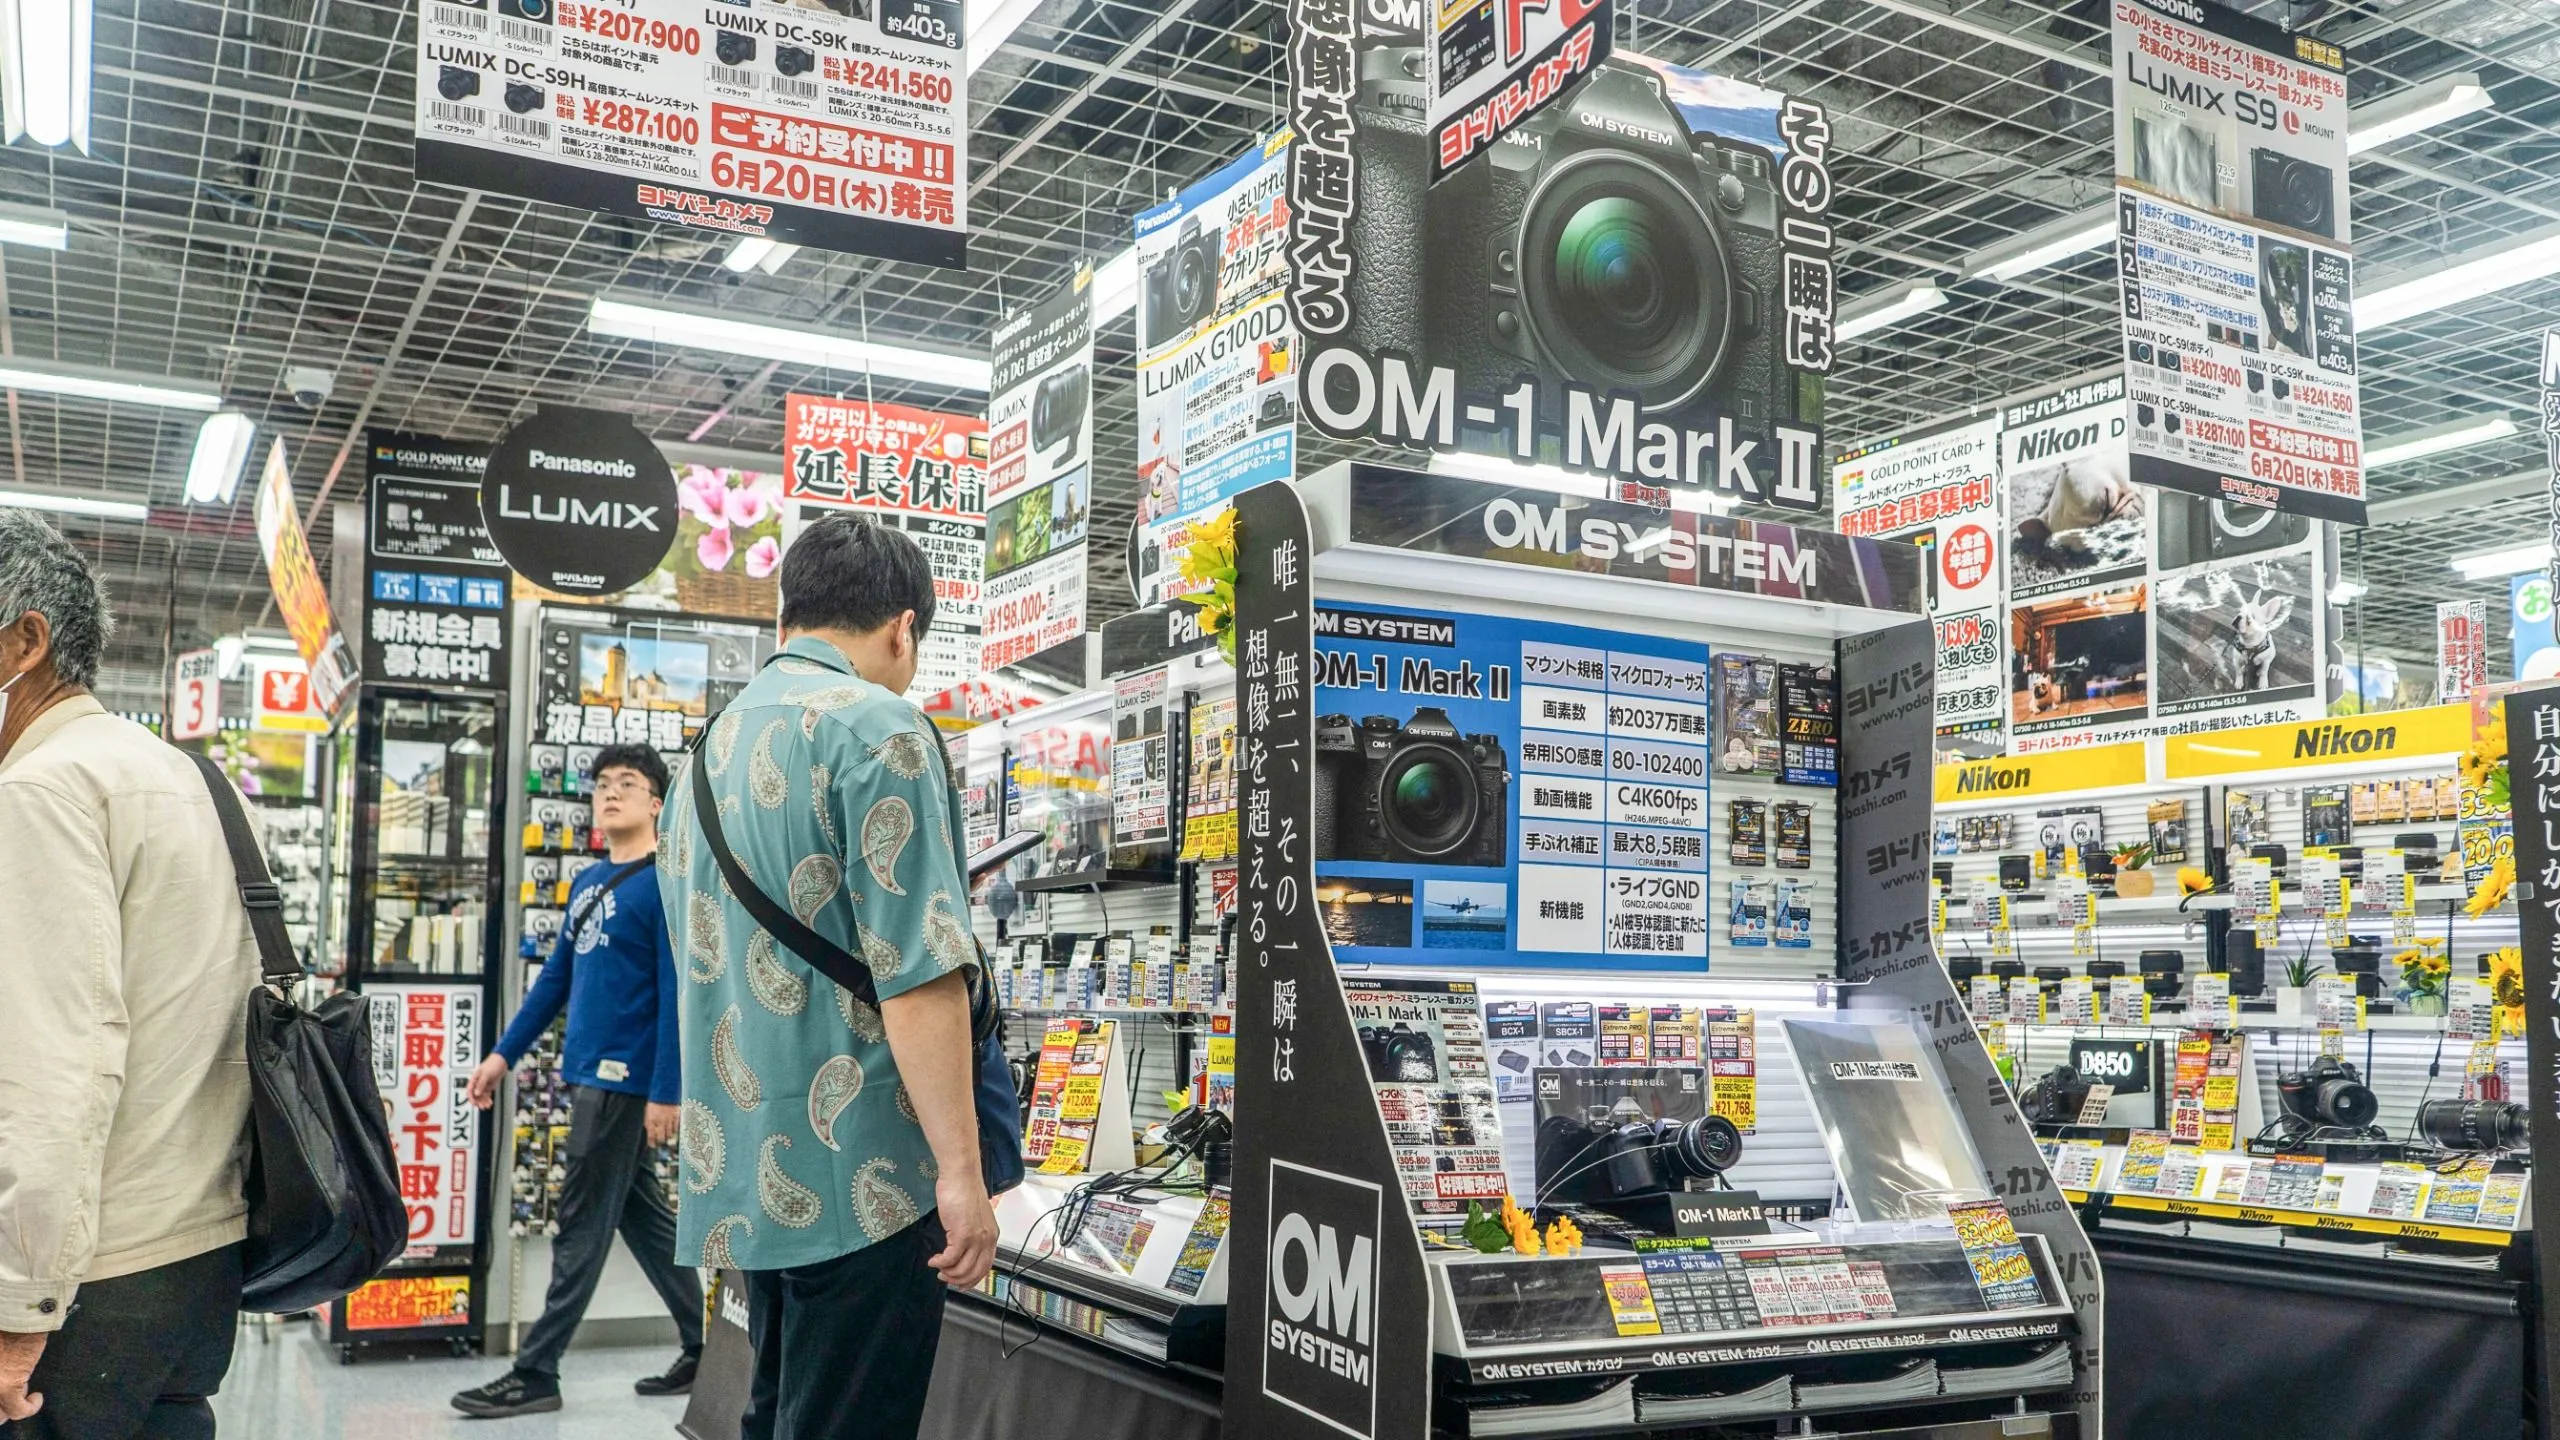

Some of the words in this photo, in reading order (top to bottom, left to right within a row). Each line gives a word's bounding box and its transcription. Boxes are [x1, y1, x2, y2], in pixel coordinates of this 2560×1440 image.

[579, 5, 700, 56] ¥207,900
[705, 8, 768, 36] LUMIX
[775, 22, 847, 51] DC-S9K
[851, 43, 952, 70] 標準ズームレンズキット
[887, 14, 957, 47] 約403g
[561, 47, 645, 73] 対象外の商品です。
[562, 35, 659, 64] こちらはポイント還元
[823, 56, 840, 69] 税込
[2116, 3, 2345, 99] この小ささでフルサイズ!描写力・操作性も
[427, 43, 497, 72] LUMIX
[505, 58, 586, 90] DC-S9H
[588, 81, 699, 112] 高倍率ズームレンズキット
[823, 68, 840, 81] 価格
[843, 58, 953, 103] ¥241,560
[2137, 32, 2324, 112] 充実の大注目ミラーレス一眼カメラ
[1440, 22, 1594, 169] ヨドバシカメラ
[2128, 50, 2226, 116] LUMIX
[2234, 90, 2278, 130] S9
[2304, 122, 2335, 140] MOUNT
[583, 96, 699, 145] ¥287,100
[828, 106, 859, 119] LUMIX
[861, 110, 868, 120] S
[870, 112, 912, 129] 20-60mm
[914, 121, 951, 135] F3.5-5.6
[1581, 112, 1603, 129] OM
[1606, 120, 1673, 146] SYSTEM
[720, 110, 945, 180] ご予約受付中!!
[562, 146, 585, 158] LUMIX
[586, 150, 592, 159] S
[593, 151, 629, 166] 28-200mm
[631, 157, 651, 169] F4-7.1
[652, 161, 679, 174] MACRO
[681, 165, 698, 178] O.I.S.
[711, 152, 954, 224] 6月20日(木)発売
[637, 183, 774, 225] ヨドバシカメラ
[1138, 202, 1183, 234] Panasonic
[646, 206, 766, 236] www.yodobashi.com
[1781, 100, 1833, 371] その一瞬は
[2124, 251, 2136, 272] 2
[2128, 293, 2140, 316] 3
[993, 310, 1032, 349] Panasonic
[2126, 324, 2156, 343] LUMIX
[2159, 333, 2214, 358] DC-S9(ボディ)
[1145, 346, 1206, 398] LUMIX
[1211, 303, 1287, 360] G100D
[2191, 357, 2242, 388] ¥207,900
[2240, 355, 2268, 373] LUMIX
[2270, 363, 2304, 380] DC-S9K
[992, 395, 1028, 428] LUMIX
[2130, 388, 2160, 405] LUMIX
[2163, 396, 2197, 414] DC-S9H
[2301, 386, 2353, 413] ¥241,560
[1307, 347, 1534, 458] OM-1
[1566, 390, 1761, 495] Mark
[2196, 420, 2245, 449] ¥287,100
[2017, 421, 2099, 464] Nikon
[396, 448, 429, 464] GOLD
[430, 452, 463, 467] POINT
[529, 449, 636, 479] Panasonic
[1870, 462, 1901, 481] GOLD
[1903, 451, 1937, 475] POINT
[1941, 441, 1973, 462] CARD
[792, 443, 987, 516] 延長保証
[2252, 451, 2361, 496] 6月20日(木)発売
[2221, 477, 2280, 500] ヨドバシカメラ
[500, 484, 660, 532] LUMIX
[1839, 474, 1992, 538] 新規会員募集中!
[1483, 498, 1568, 553] OM
[1580, 517, 1817, 587] SYSTEM
[372, 607, 502, 649] 新規会員
[1343, 616, 1454, 643] SYSTEM
[383, 643, 491, 682] 募集中!
[1523, 654, 1605, 681] マウント規格
[1400, 656, 1483, 700] Mark
[1488, 663, 1511, 702] II
[186, 681, 204, 732] 3
[1115, 694, 1139, 710] LUMIX
[2158, 705, 2178, 715] D7500
[1542, 699, 1586, 723] 画素数
[1608, 705, 1706, 737] 約2037万画素
[1786, 718, 1834, 737] ZERO
[2018, 732, 2094, 752] ヨドバシカメラ
[2293, 723, 2396, 760] Nikon
[1522, 742, 1604, 768] 常用ISO感度
[1611, 749, 1703, 778] 80-102400
[1956, 765, 2030, 794] Nikon
[1245, 627, 1271, 969] 想像を超える。
[1533, 787, 1593, 811] 動画機能
[1617, 785, 1698, 813] C4K60fps
[1525, 832, 1600, 856] 手ぶれ補正
[1613, 833, 1701, 858] 最大8,5段階
[1539, 900, 1585, 920] 新機能
[1608, 934, 1684, 951] 「人体認識」を追加
[1215, 1019, 1229, 1030] NEW
[1388, 1006, 1423, 1021] Mark
[1603, 1024, 1628, 1032] Extreme
[1629, 1023, 1643, 1032] PRO
[1501, 1026, 1525, 1036] BCX-1
[1555, 1027, 1583, 1037] SBCX-1
[1655, 1025, 1680, 1033] Extreme
[1680, 1024, 1694, 1033] PRO
[1711, 1026, 1736, 1034] Extreme
[1736, 1025, 1750, 1034] PRO
[2079, 1050, 2134, 1077] D850
[2322, 1067, 2341, 1075] Nikon
[1540, 1078, 1559, 1091] OM
[399, 993, 446, 1240] 買取り・下取り
[1715, 1100, 1750, 1115] ¥21,768
[2175, 1107, 2200, 1122] 限定
[1031, 1119, 1058, 1136] 限定
[2175, 1122, 2200, 1138] 特価
[2250, 1143, 2277, 1155] Nikon
[1677, 1208, 1715, 1224] OM-1
[1718, 1207, 1752, 1223] Mark
[2166, 1201, 2200, 1216] Nikon
[2238, 1207, 2275, 1223] Nikon
[2315, 1216, 2355, 1231] Nikon
[2399, 1224, 2440, 1240] Nikon
[1645, 1258, 1677, 1269] ミラーレス
[1271, 1211, 1373, 1347] OM
[1806, 1339, 1829, 1353] OM
[1829, 1335, 1893, 1351] SYSTEM
[1894, 1332, 1926, 1348] カタログ
[1949, 1327, 1971, 1342] OM
[1971, 1325, 2028, 1339] SYSTEM
[1270, 1318, 1369, 1387] SYSTEM
[1652, 1351, 1677, 1367] OM
[1678, 1347, 1744, 1364] SYSTEM
[1746, 1344, 1781, 1359] カタログ
[1482, 1365, 1510, 1380] OM
[1511, 1360, 1582, 1377] SYSTEM
[1586, 1356, 1624, 1371] カタログ
